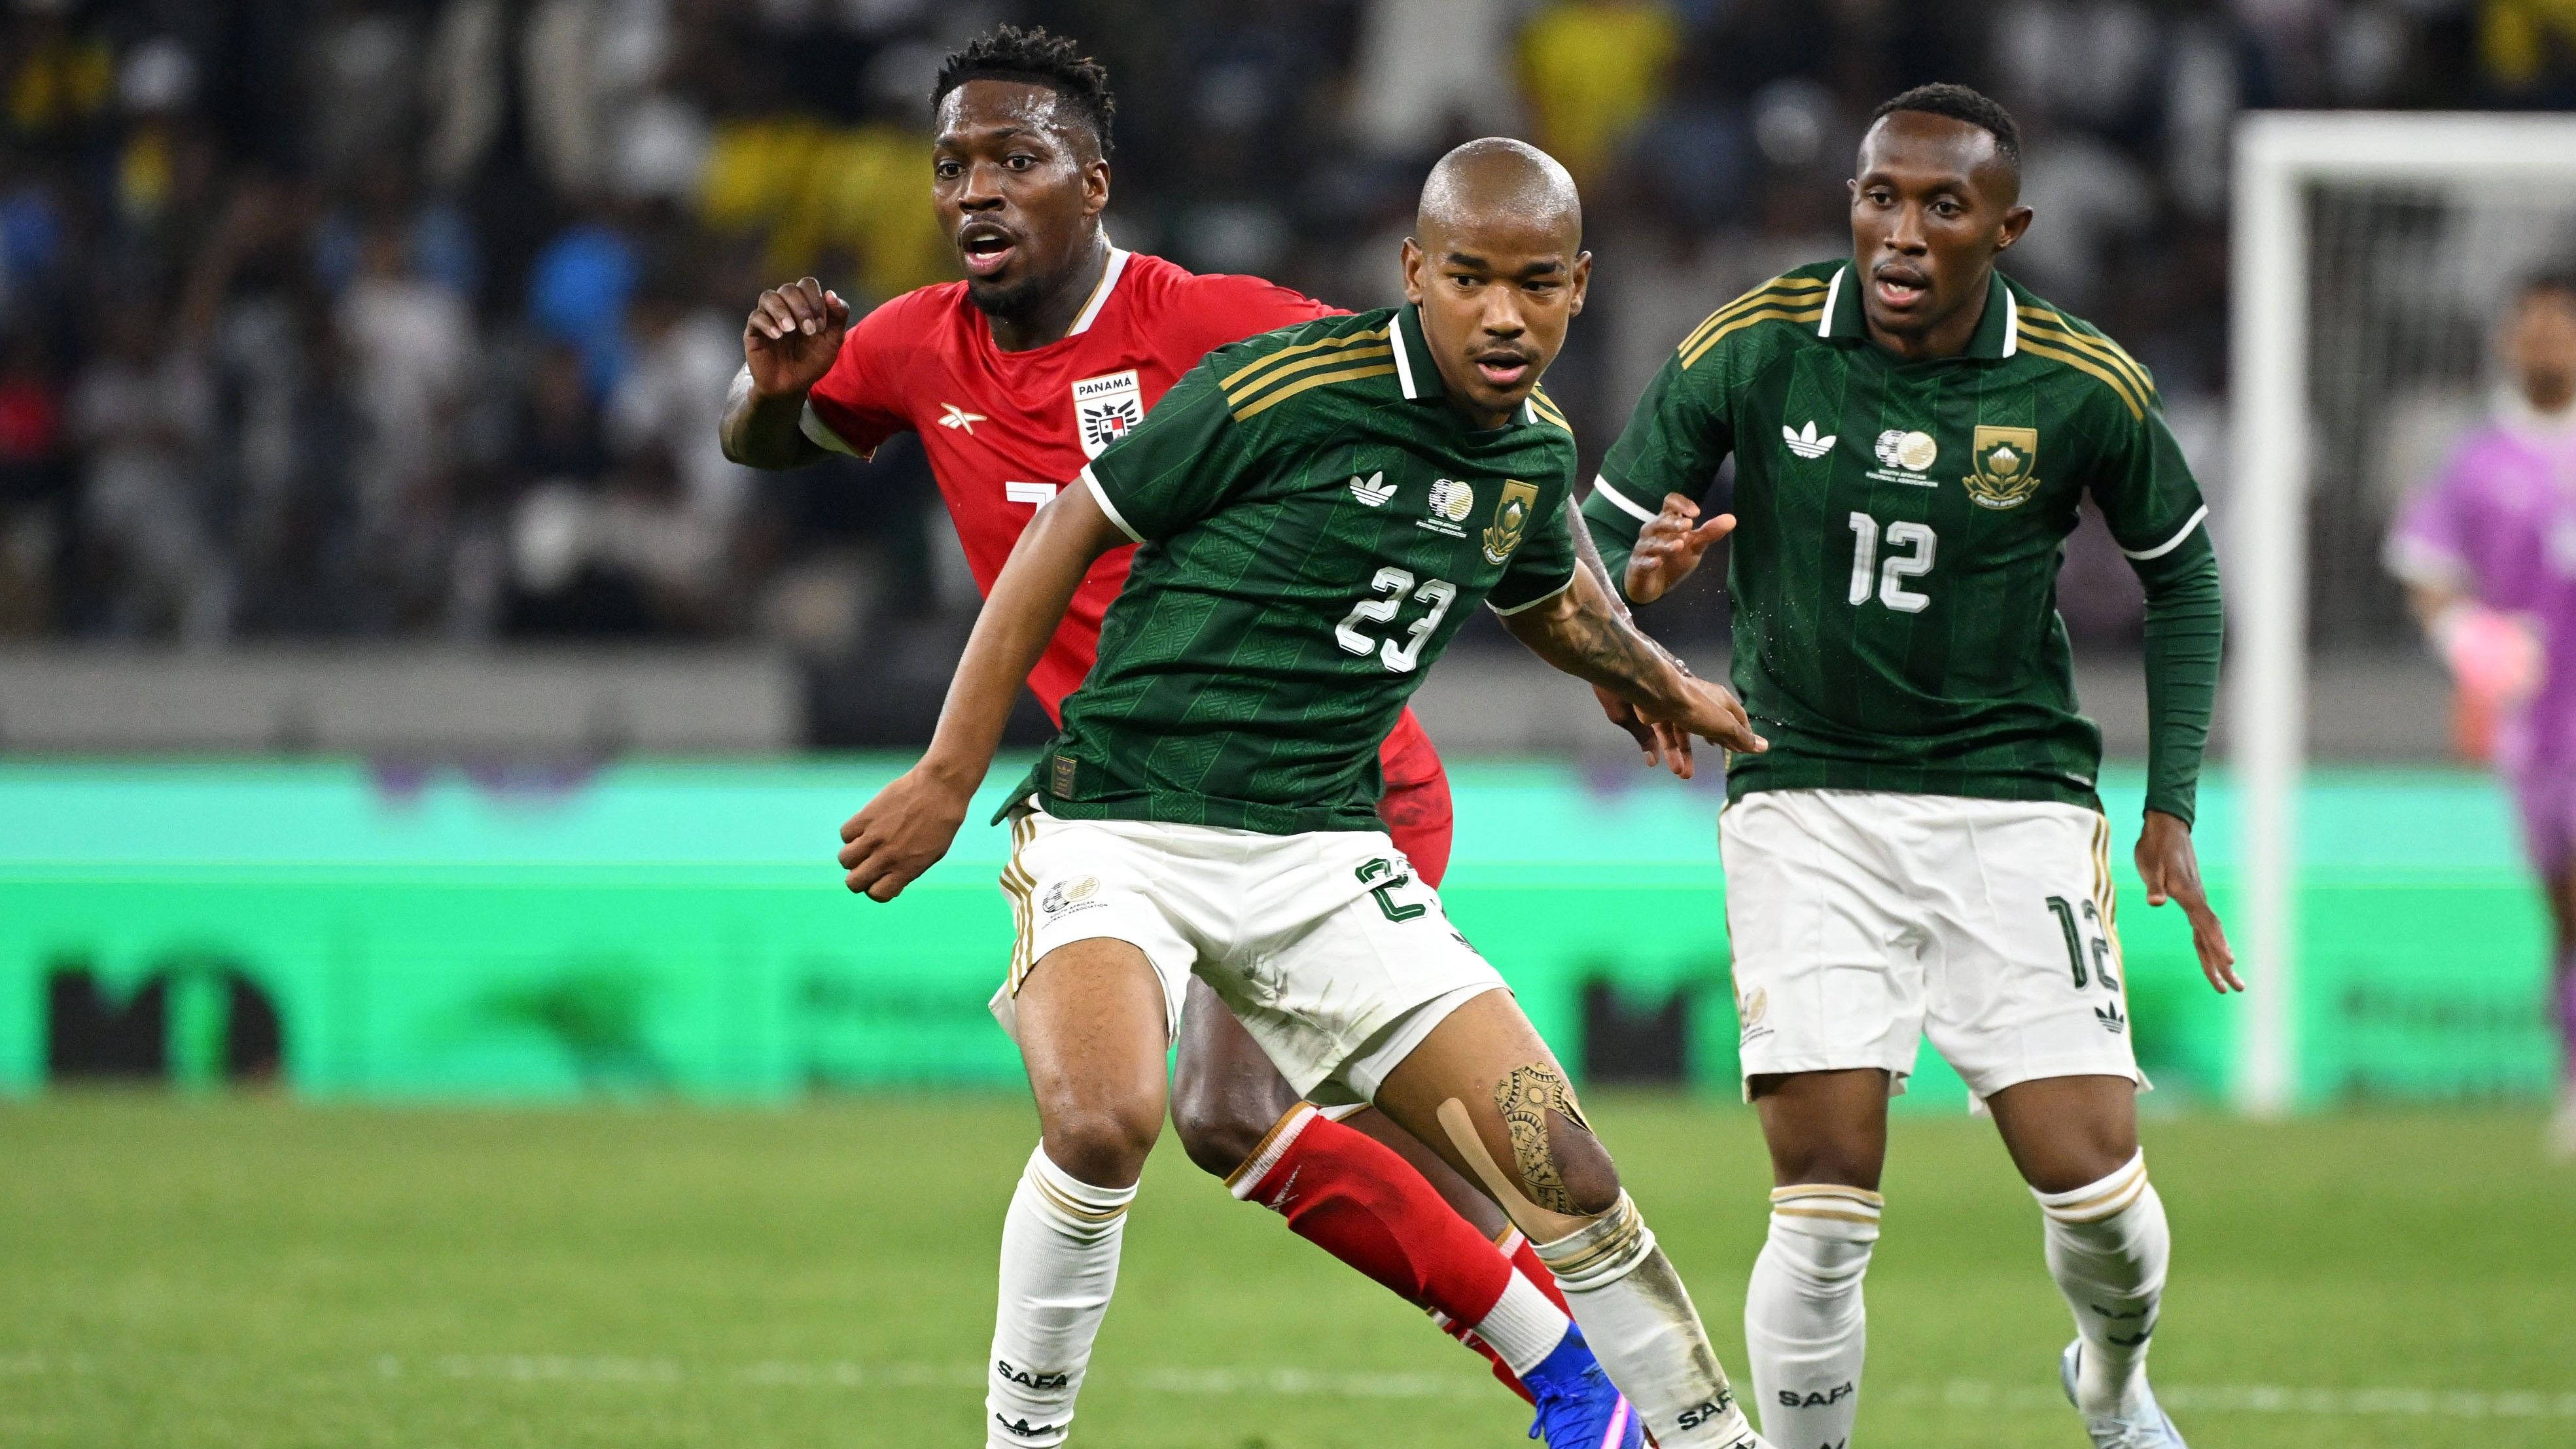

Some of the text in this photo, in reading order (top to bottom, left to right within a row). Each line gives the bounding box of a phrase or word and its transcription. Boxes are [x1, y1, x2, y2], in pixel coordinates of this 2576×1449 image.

[1848, 511, 1937, 613] 12
[1335, 566, 1456, 673] 23
[1068, 903, 1108, 915] ASSOCIATION
[2045, 894, 2119, 992] 12
[997, 1360, 1068, 1389] SAFA
